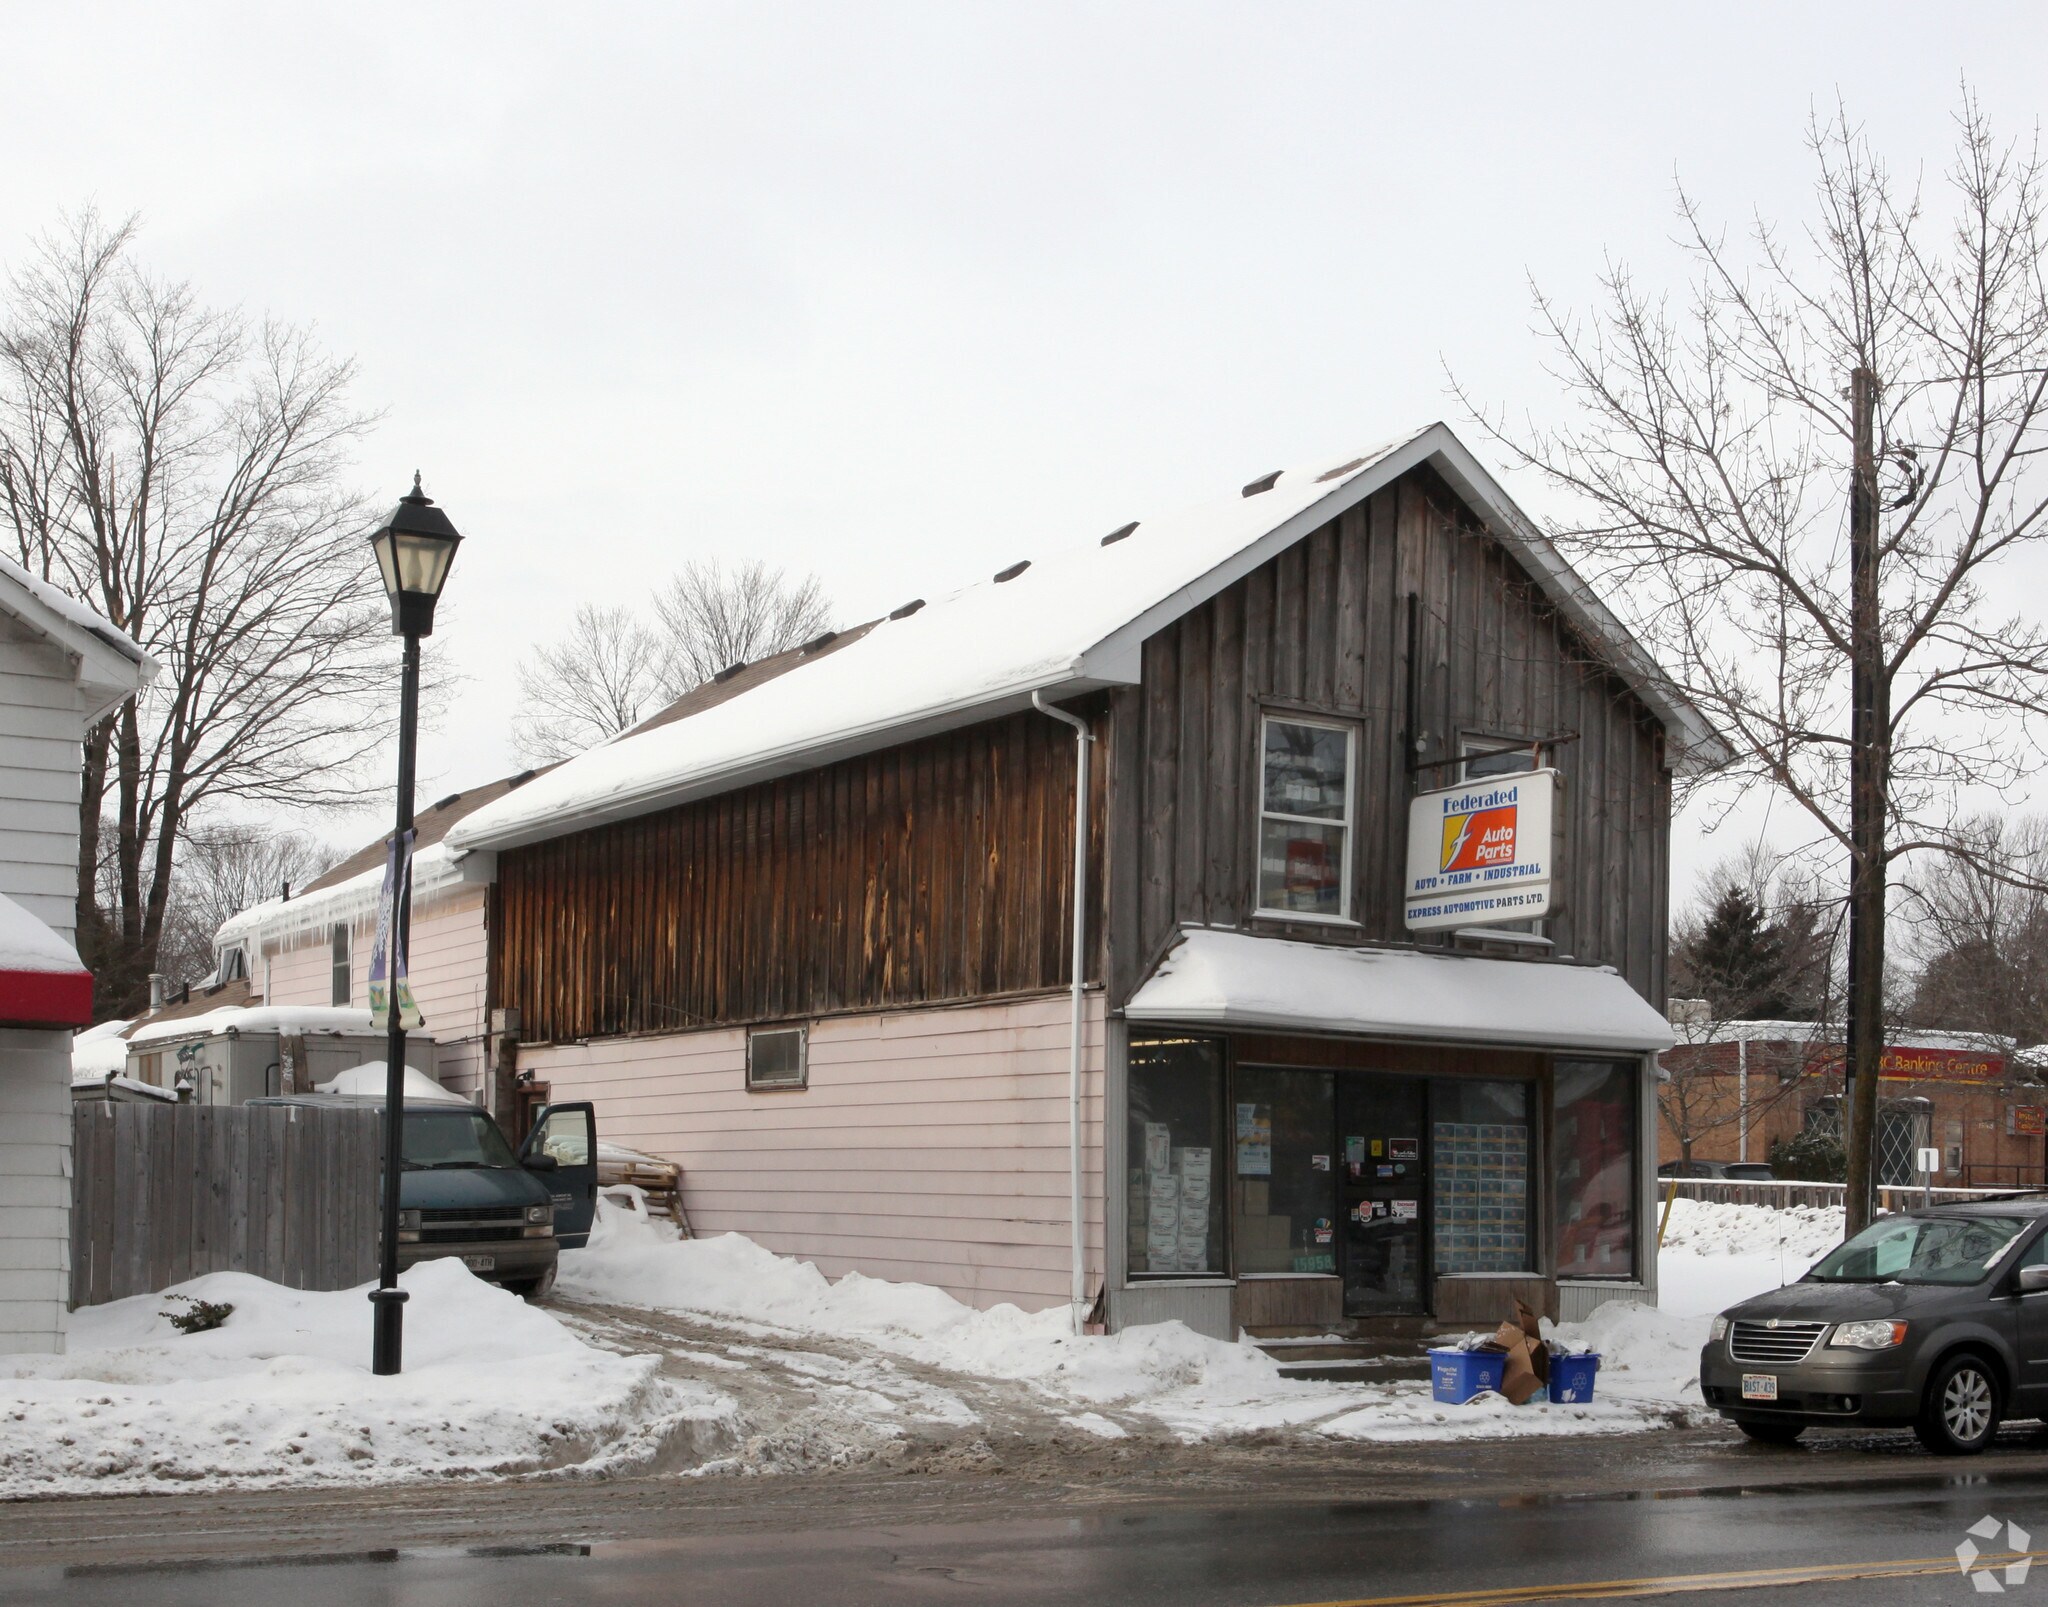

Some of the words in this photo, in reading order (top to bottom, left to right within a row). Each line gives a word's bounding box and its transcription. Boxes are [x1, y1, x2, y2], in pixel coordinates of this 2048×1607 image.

[1443, 786, 1518, 813] Federated
[1481, 826, 1514, 844] Auto
[1476, 843, 1513, 861] Parts
[1414, 877, 1438, 890] AUTO
[1447, 872, 1472, 886] FARM
[1483, 863, 1541, 881] INDUSTRIAL
[1407, 906, 1442, 919] EXPRESS
[1443, 899, 1495, 914] AUTOMOTIVE
[1496, 895, 1525, 908] PARTS
[1895, 1056, 1945, 1077] Banking
[1947, 1058, 1988, 1075] Centre
[1295, 1255, 1333, 1272] 15958
